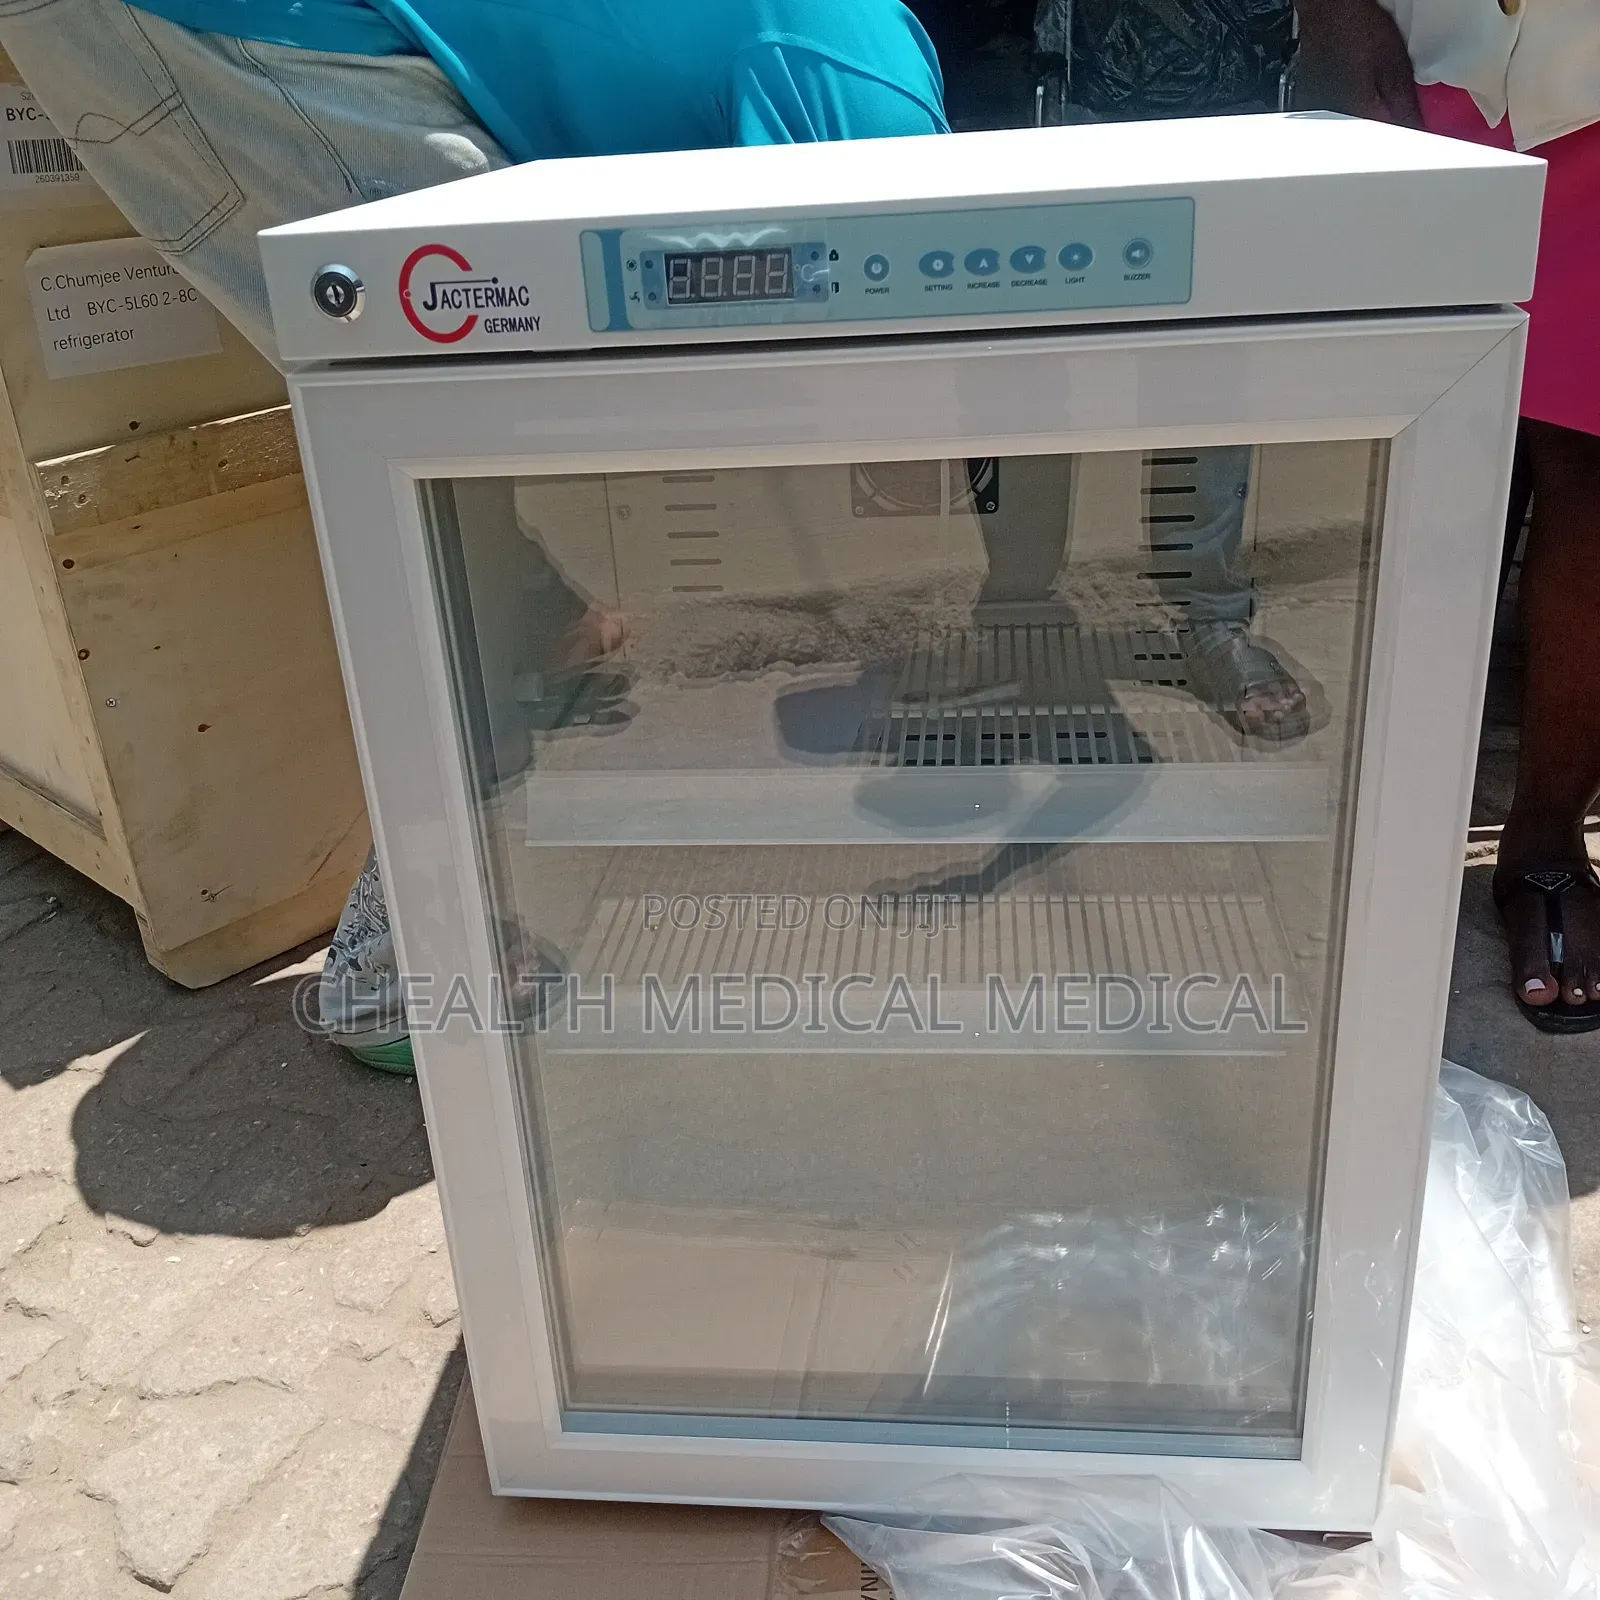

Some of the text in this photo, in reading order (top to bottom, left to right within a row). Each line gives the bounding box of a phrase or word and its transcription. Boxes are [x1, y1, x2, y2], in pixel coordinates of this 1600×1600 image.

[5, 107, 51, 121] BYC-
[1064, 276, 1085, 285] LIGHT
[1123, 272, 1151, 281] BUZZER
[967, 281, 1000, 289] INCREASE
[1011, 278, 1047, 287] DECREASE
[865, 287, 890, 295] POWER
[924, 284, 953, 292] SETTING
[422, 277, 530, 311] JACTERMAC
[47, 304, 71, 322] Ltd
[163, 288, 198, 305] 2-8C
[484, 316, 541, 333] GERMANY
[53, 329, 135, 351] refrigerator
